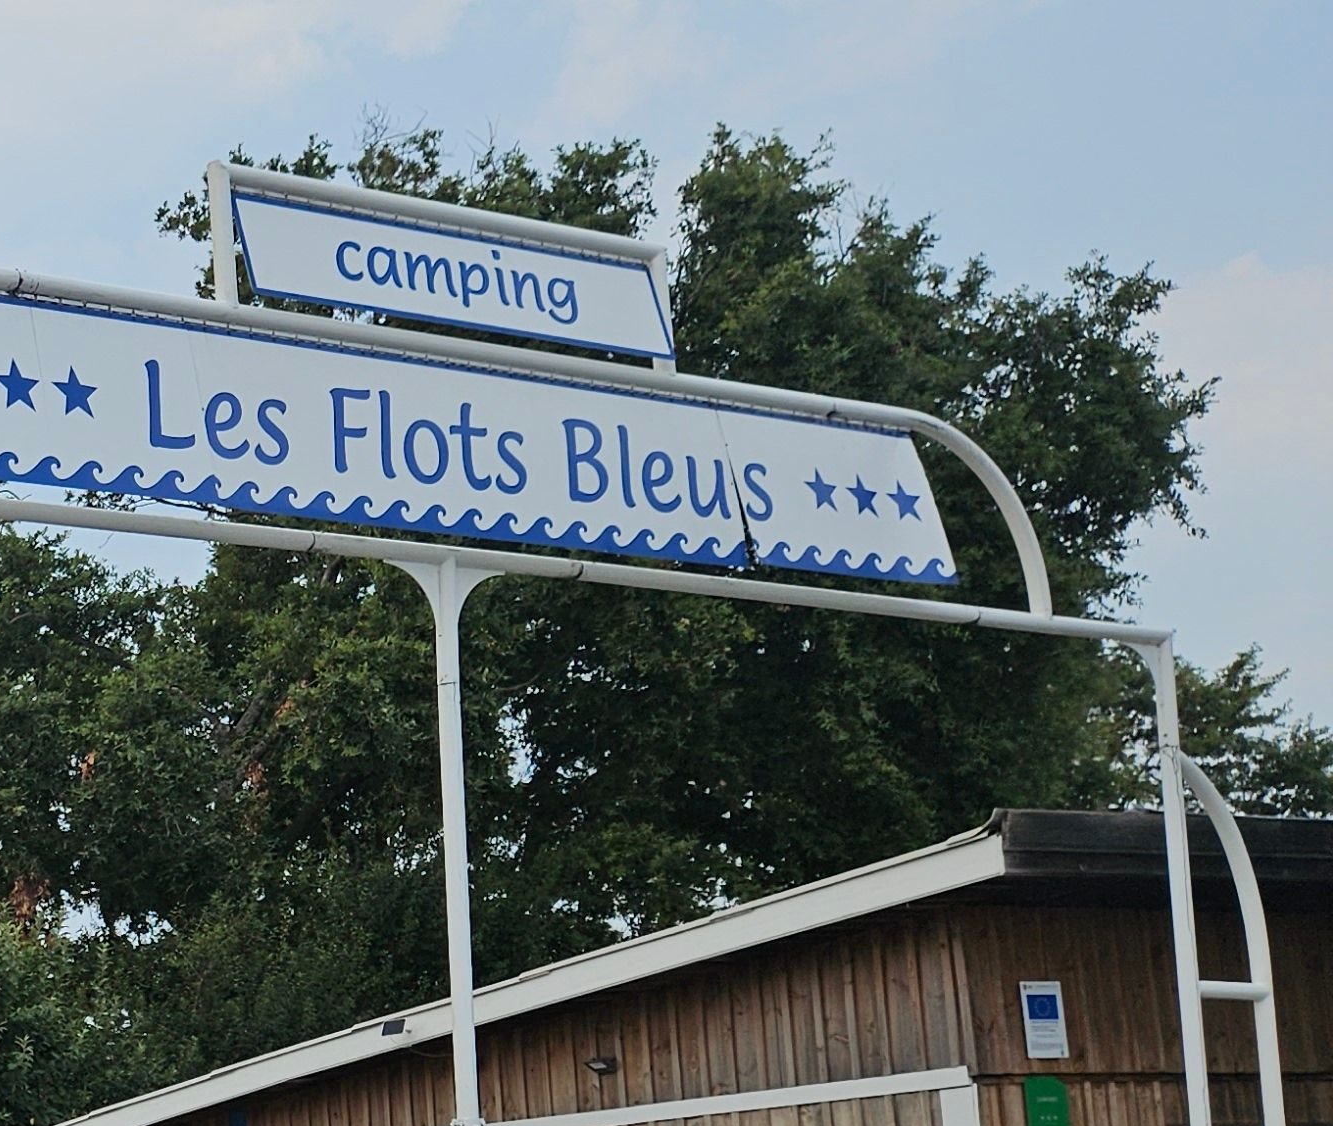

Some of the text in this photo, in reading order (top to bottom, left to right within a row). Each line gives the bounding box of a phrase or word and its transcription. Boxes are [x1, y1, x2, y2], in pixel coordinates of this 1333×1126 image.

[335, 240, 579, 325] camping
[144, 359, 774, 522] Les Flots Bleus
